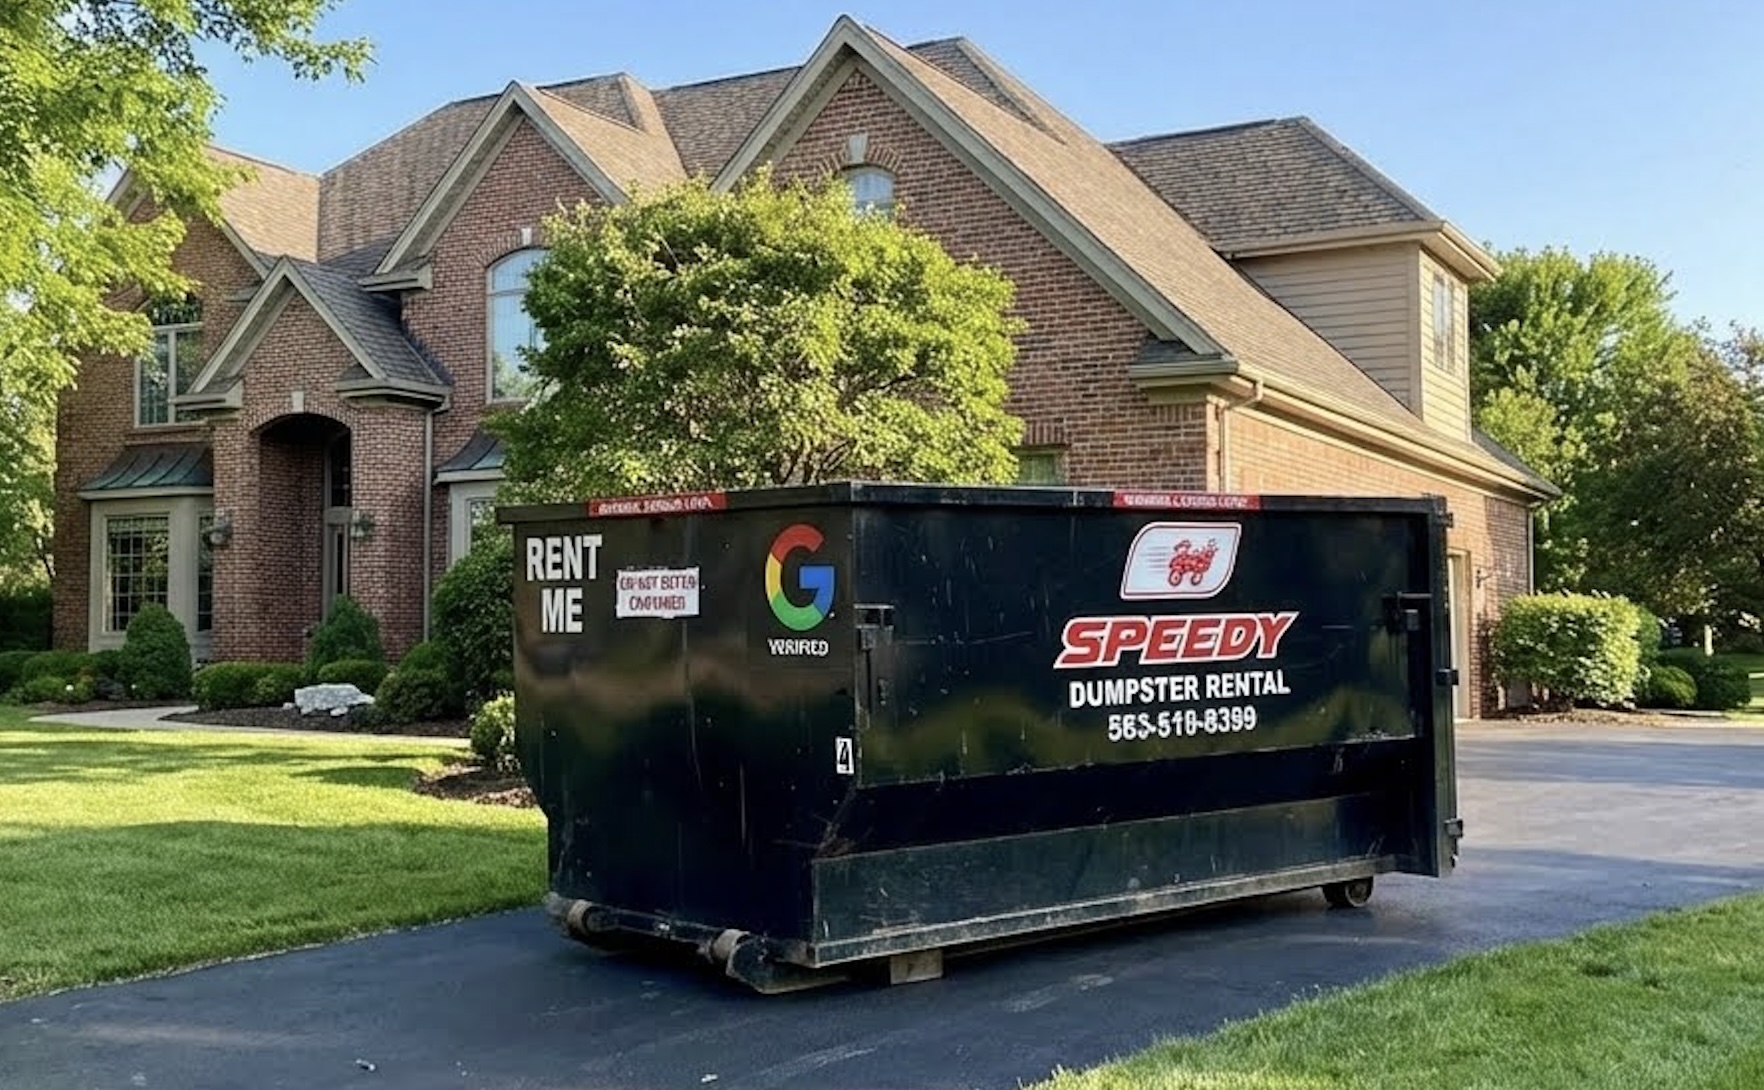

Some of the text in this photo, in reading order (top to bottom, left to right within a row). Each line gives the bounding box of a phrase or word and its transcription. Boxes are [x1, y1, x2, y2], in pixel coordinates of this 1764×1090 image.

[526, 534, 603, 582] RENT
[765, 524, 835, 631] G
[541, 587, 583, 634] ME
[1053, 611, 1299, 669] SPEEDY
[1069, 668, 1291, 709] DUMPSTER RENTAL
